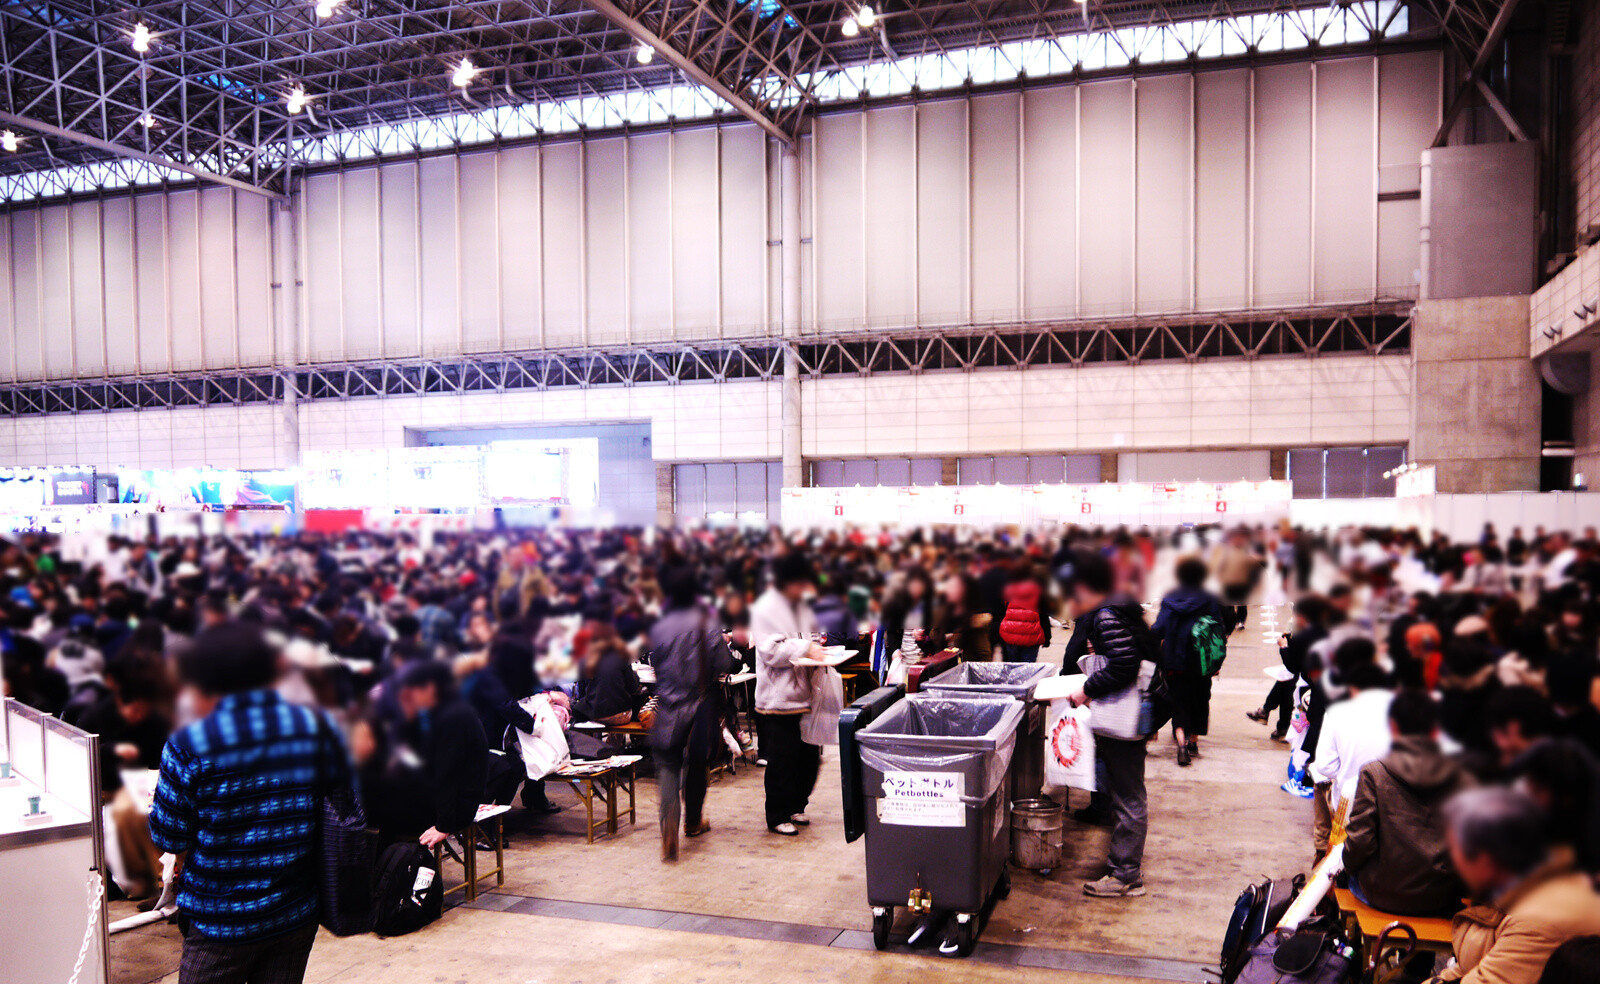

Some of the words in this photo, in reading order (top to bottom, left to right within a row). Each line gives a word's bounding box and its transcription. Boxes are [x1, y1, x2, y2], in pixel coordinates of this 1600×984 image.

[836, 506, 842, 515] 1
[955, 505, 963, 514] 2
[1083, 503, 1090, 513] 3
[1217, 502, 1225, 512] 4
